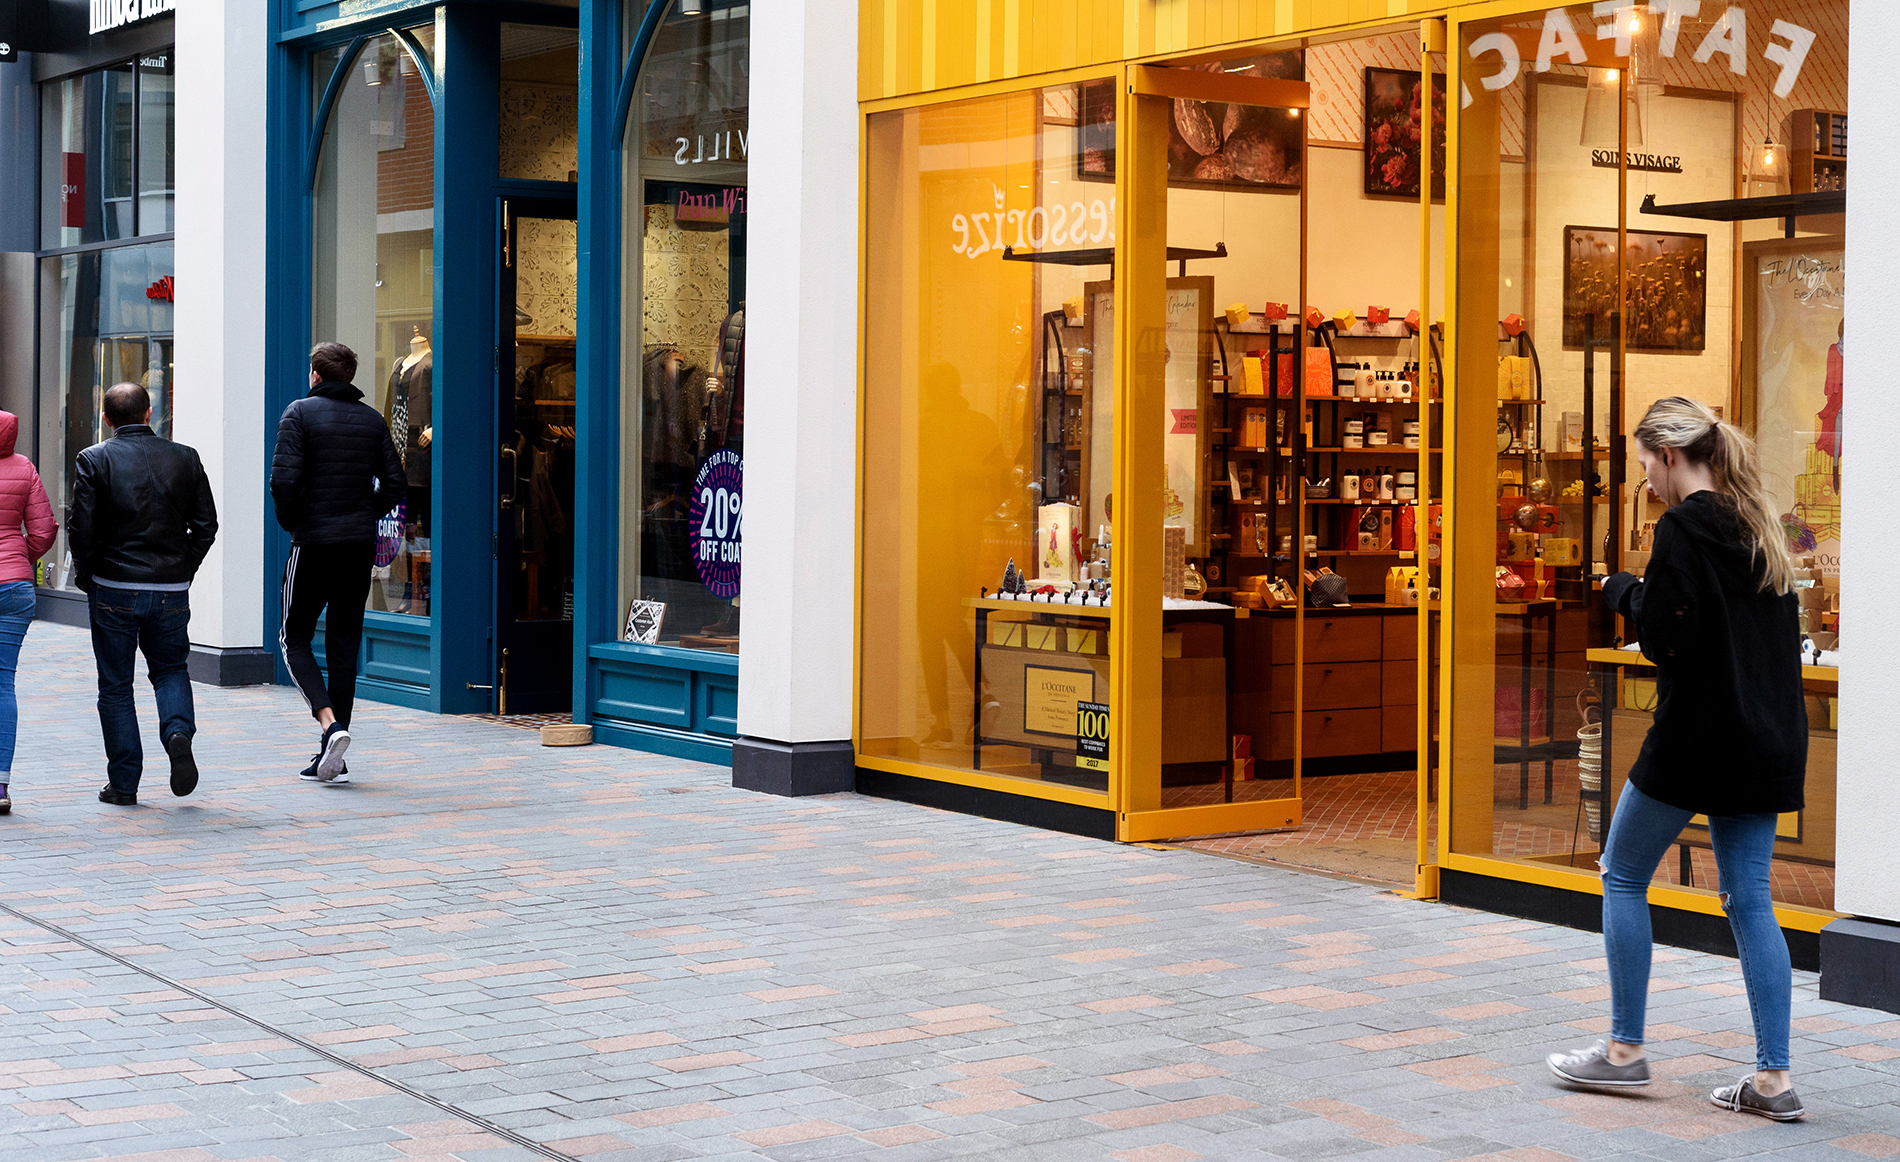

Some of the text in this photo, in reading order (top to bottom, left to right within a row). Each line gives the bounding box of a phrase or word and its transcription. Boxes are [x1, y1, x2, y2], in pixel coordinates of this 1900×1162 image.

[1634, 153, 1681, 169] VISAGE
[676, 190, 716, 220] Run
[696, 463, 709, 486] TIME
[709, 453, 721, 469] FOR
[722, 451, 726, 463] A
[728, 452, 739, 466] TOP
[700, 487, 744, 539] 20%
[378, 519, 399, 538] COATS
[700, 540, 718, 561] OFF
[1077, 710, 1109, 740] 100
[1086, 759, 1099, 768] 2017
